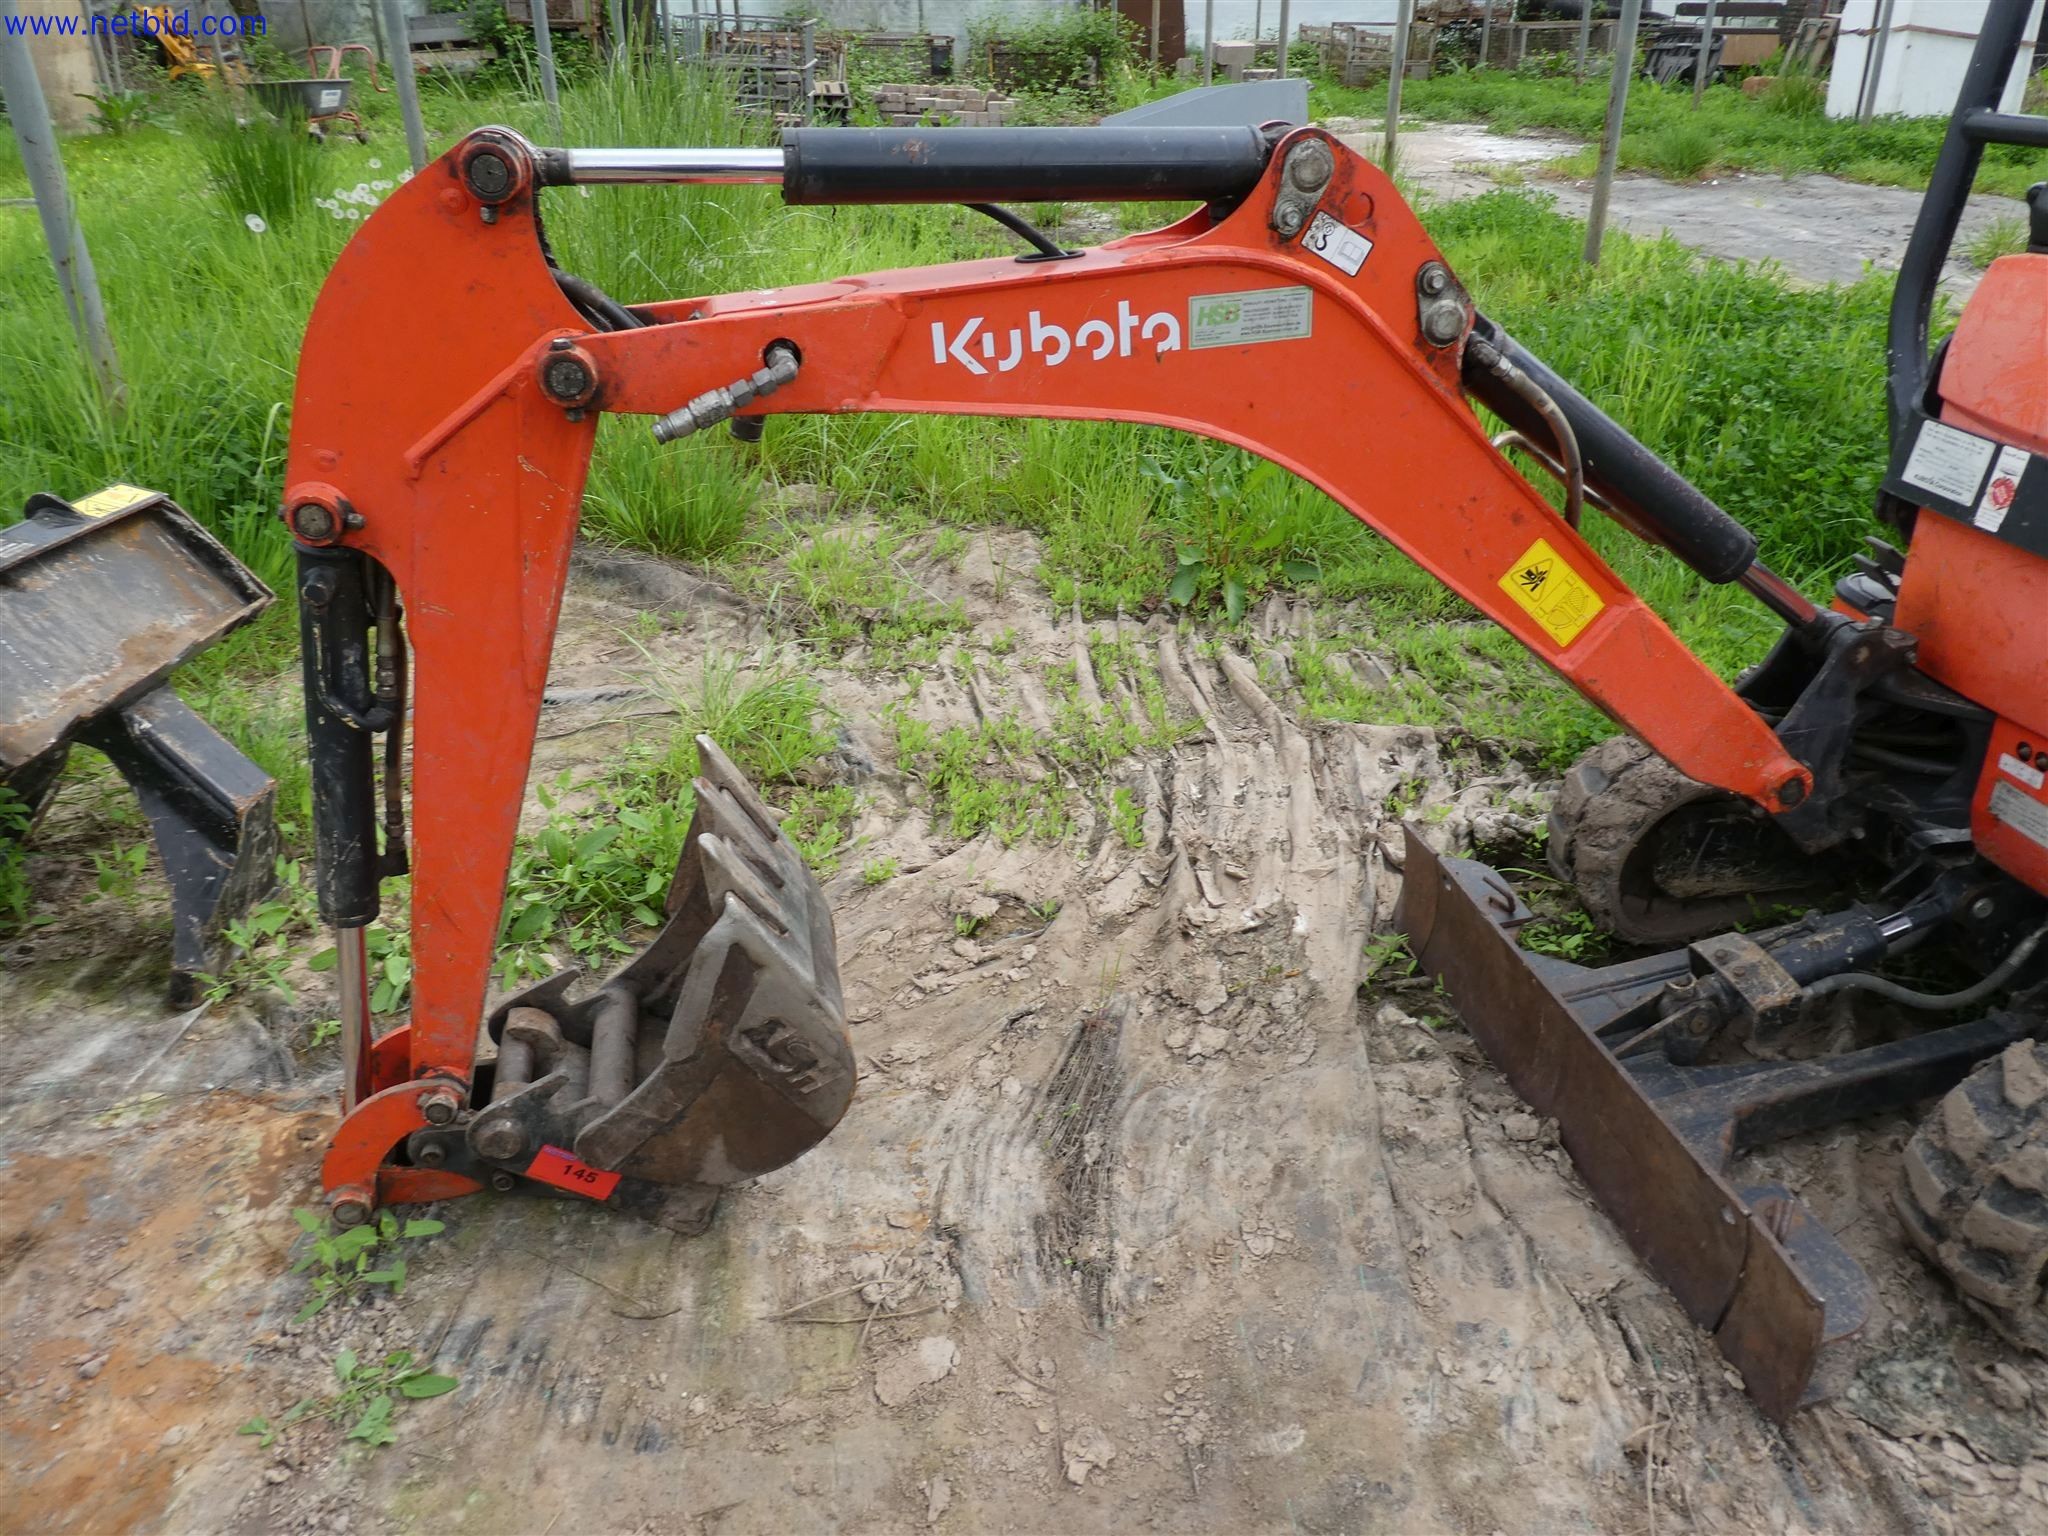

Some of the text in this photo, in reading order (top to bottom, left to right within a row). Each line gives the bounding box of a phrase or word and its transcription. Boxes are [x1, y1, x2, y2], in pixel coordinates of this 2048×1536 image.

[1196, 302, 1241, 327] HSB
[930, 300, 1181, 375] Kubota
[563, 1165, 599, 1184] 145
